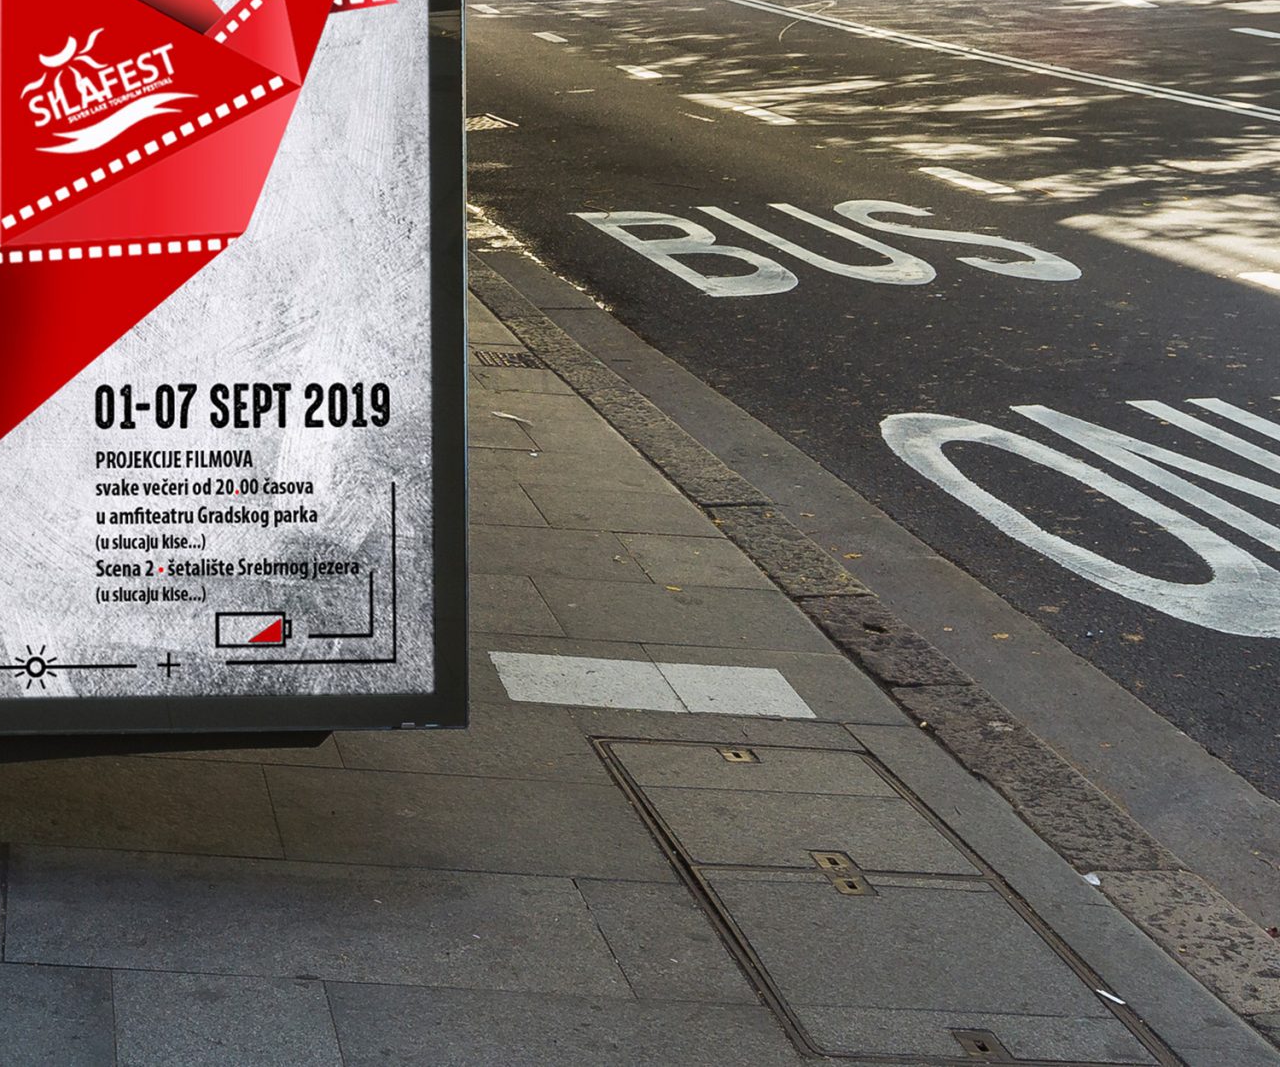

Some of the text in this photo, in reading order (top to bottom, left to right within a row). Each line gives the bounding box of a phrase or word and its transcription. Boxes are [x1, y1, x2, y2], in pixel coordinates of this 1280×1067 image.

[571, 199, 1083, 297] BUS
[95, 382, 391, 430] 01-07 SEPT 2019
[96, 449, 253, 469] PROJEKCIJE FILMOVA
[95, 478, 139, 496] svake
[142, 478, 189, 496] večeri
[192, 477, 212, 495] od
[262, 477, 314, 495] časova
[96, 505, 318, 528] u amfiteatru Gradskog parka
[95, 534, 109, 552] (u
[112, 534, 158, 553] slucaju
[96, 557, 360, 580] Scena 2 šetalište Srebrnog jezera
[95, 587, 110, 604] (u
[112, 586, 159, 605] slucaju
